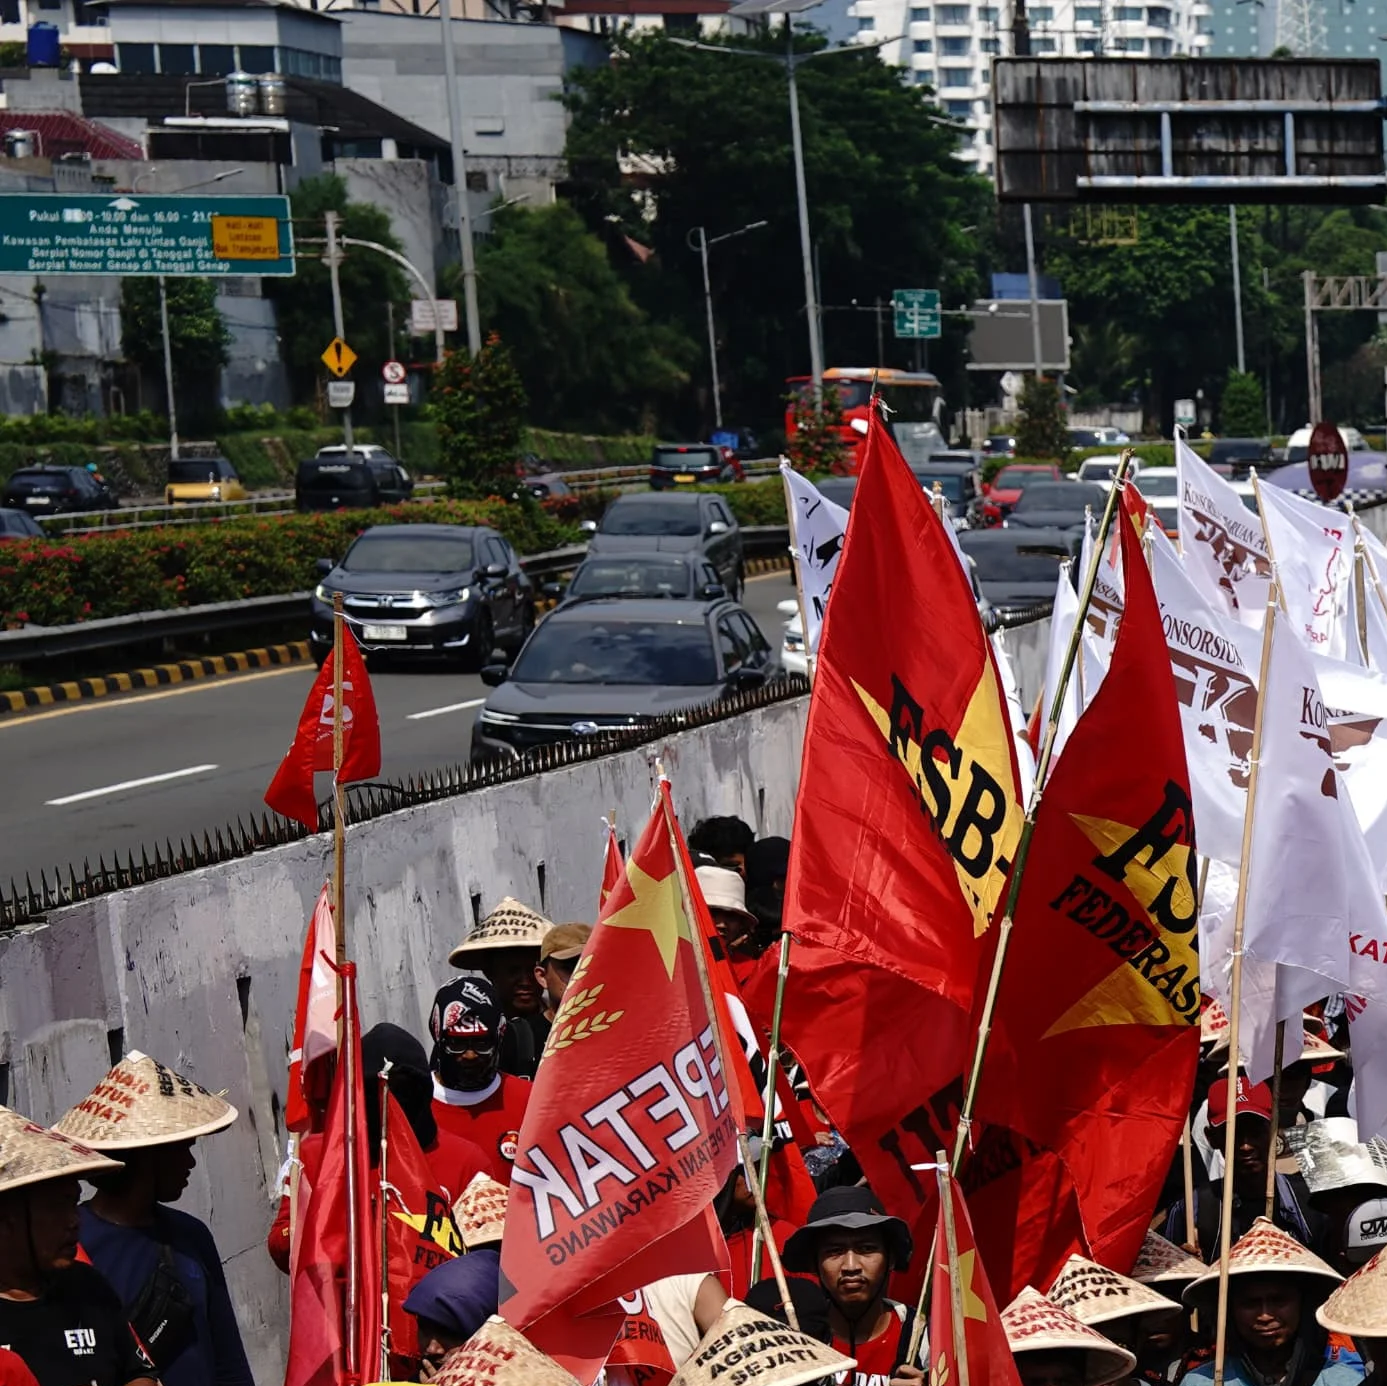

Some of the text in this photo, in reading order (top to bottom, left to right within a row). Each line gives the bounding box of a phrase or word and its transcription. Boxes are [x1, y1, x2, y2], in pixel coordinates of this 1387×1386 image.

[90, 224, 162, 234] Anda Menuju
[3, 236, 117, 246] Kawasan Pembatasan
[64, 1329, 95, 1349] ETU
[729, 1350, 819, 1386] SEJATI
